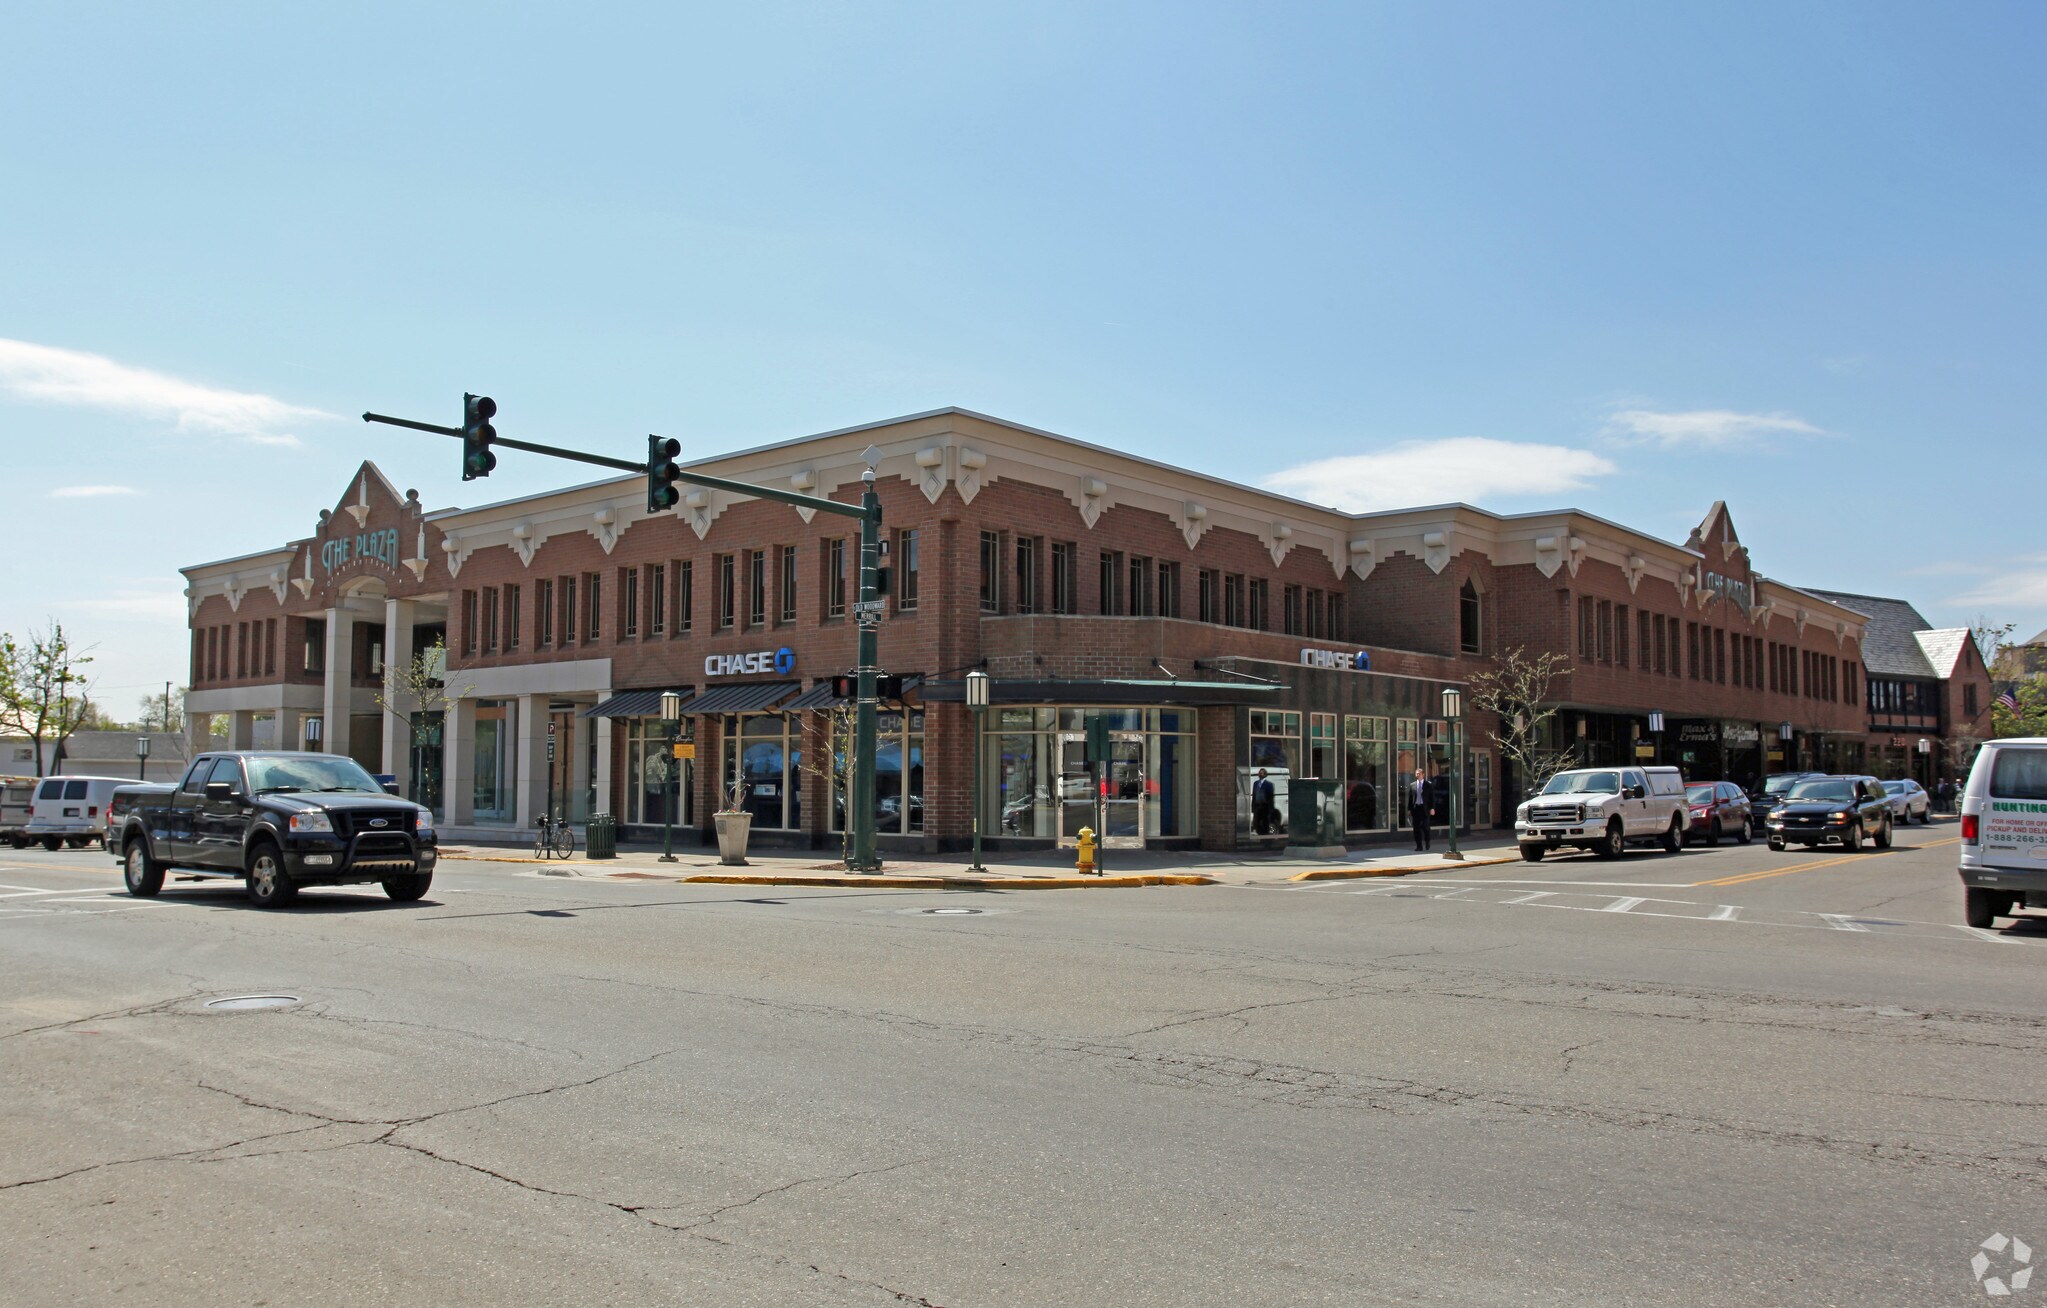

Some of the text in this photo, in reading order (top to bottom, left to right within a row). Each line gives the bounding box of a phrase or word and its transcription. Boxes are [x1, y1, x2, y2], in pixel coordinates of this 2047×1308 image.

[322, 528, 399, 576] THE PLAZA
[705, 651, 774, 675] CHASE
[1301, 648, 1354, 669] CHASE
[880, 715, 921, 728] CHAE
[1992, 802, 2047, 813] HUNTING
